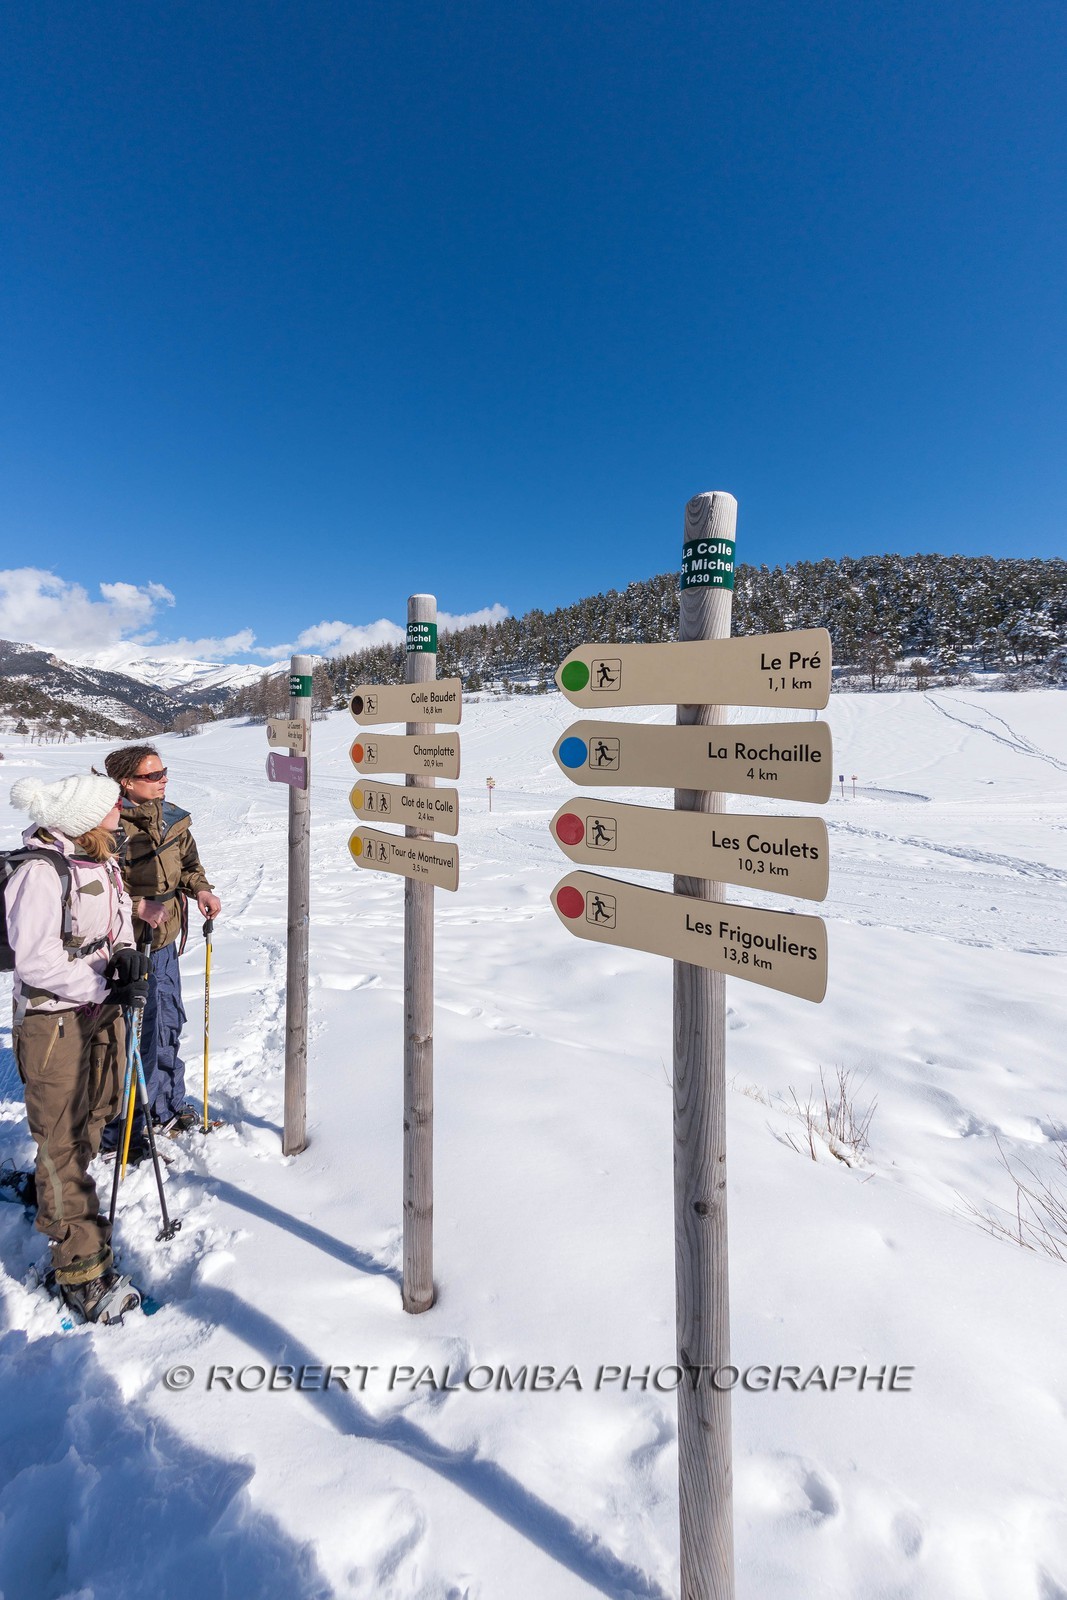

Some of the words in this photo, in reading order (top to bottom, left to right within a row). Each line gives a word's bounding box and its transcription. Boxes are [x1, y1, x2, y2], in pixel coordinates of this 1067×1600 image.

[697, 542, 732, 556] Colle
[691, 558, 734, 573] Michel
[686, 573, 710, 585] 1430
[713, 575, 723, 583] m
[408, 624, 429, 632] Colle
[760, 653, 782, 670] Le
[789, 651, 821, 669] Pré
[768, 677, 786, 692] 1,1
[792, 677, 812, 689] km
[410, 693, 429, 703] Colle
[430, 691, 456, 703] Baudet
[423, 706, 434, 714] 16,8
[434, 706, 443, 714] km
[413, 745, 455, 758] Champlatte
[708, 742, 728, 759] La
[735, 742, 822, 763] Rochaille
[423, 759, 435, 768] 20,9
[435, 760, 443, 768] km
[746, 768, 755, 779] 4
[759, 768, 778, 781] km
[401, 795, 415, 807] Clot
[416, 798, 425, 809] de
[426, 799, 433, 810] la
[434, 800, 453, 813] Colle
[418, 812, 426, 821] 2,4
[426, 813, 435, 822] km
[712, 830, 740, 850] Les
[746, 834, 819, 860] Coulets
[391, 844, 406, 857] Tour
[407, 849, 416, 860] de
[417, 851, 454, 868] Montruvel
[412, 863, 421, 872] 3,5
[421, 864, 429, 874] km
[738, 858, 765, 874] 10,3
[769, 863, 789, 877] km
[686, 914, 712, 936] Les
[719, 921, 817, 960] Frigouliers
[723, 947, 749, 965] 13,8
[753, 954, 773, 970] km
